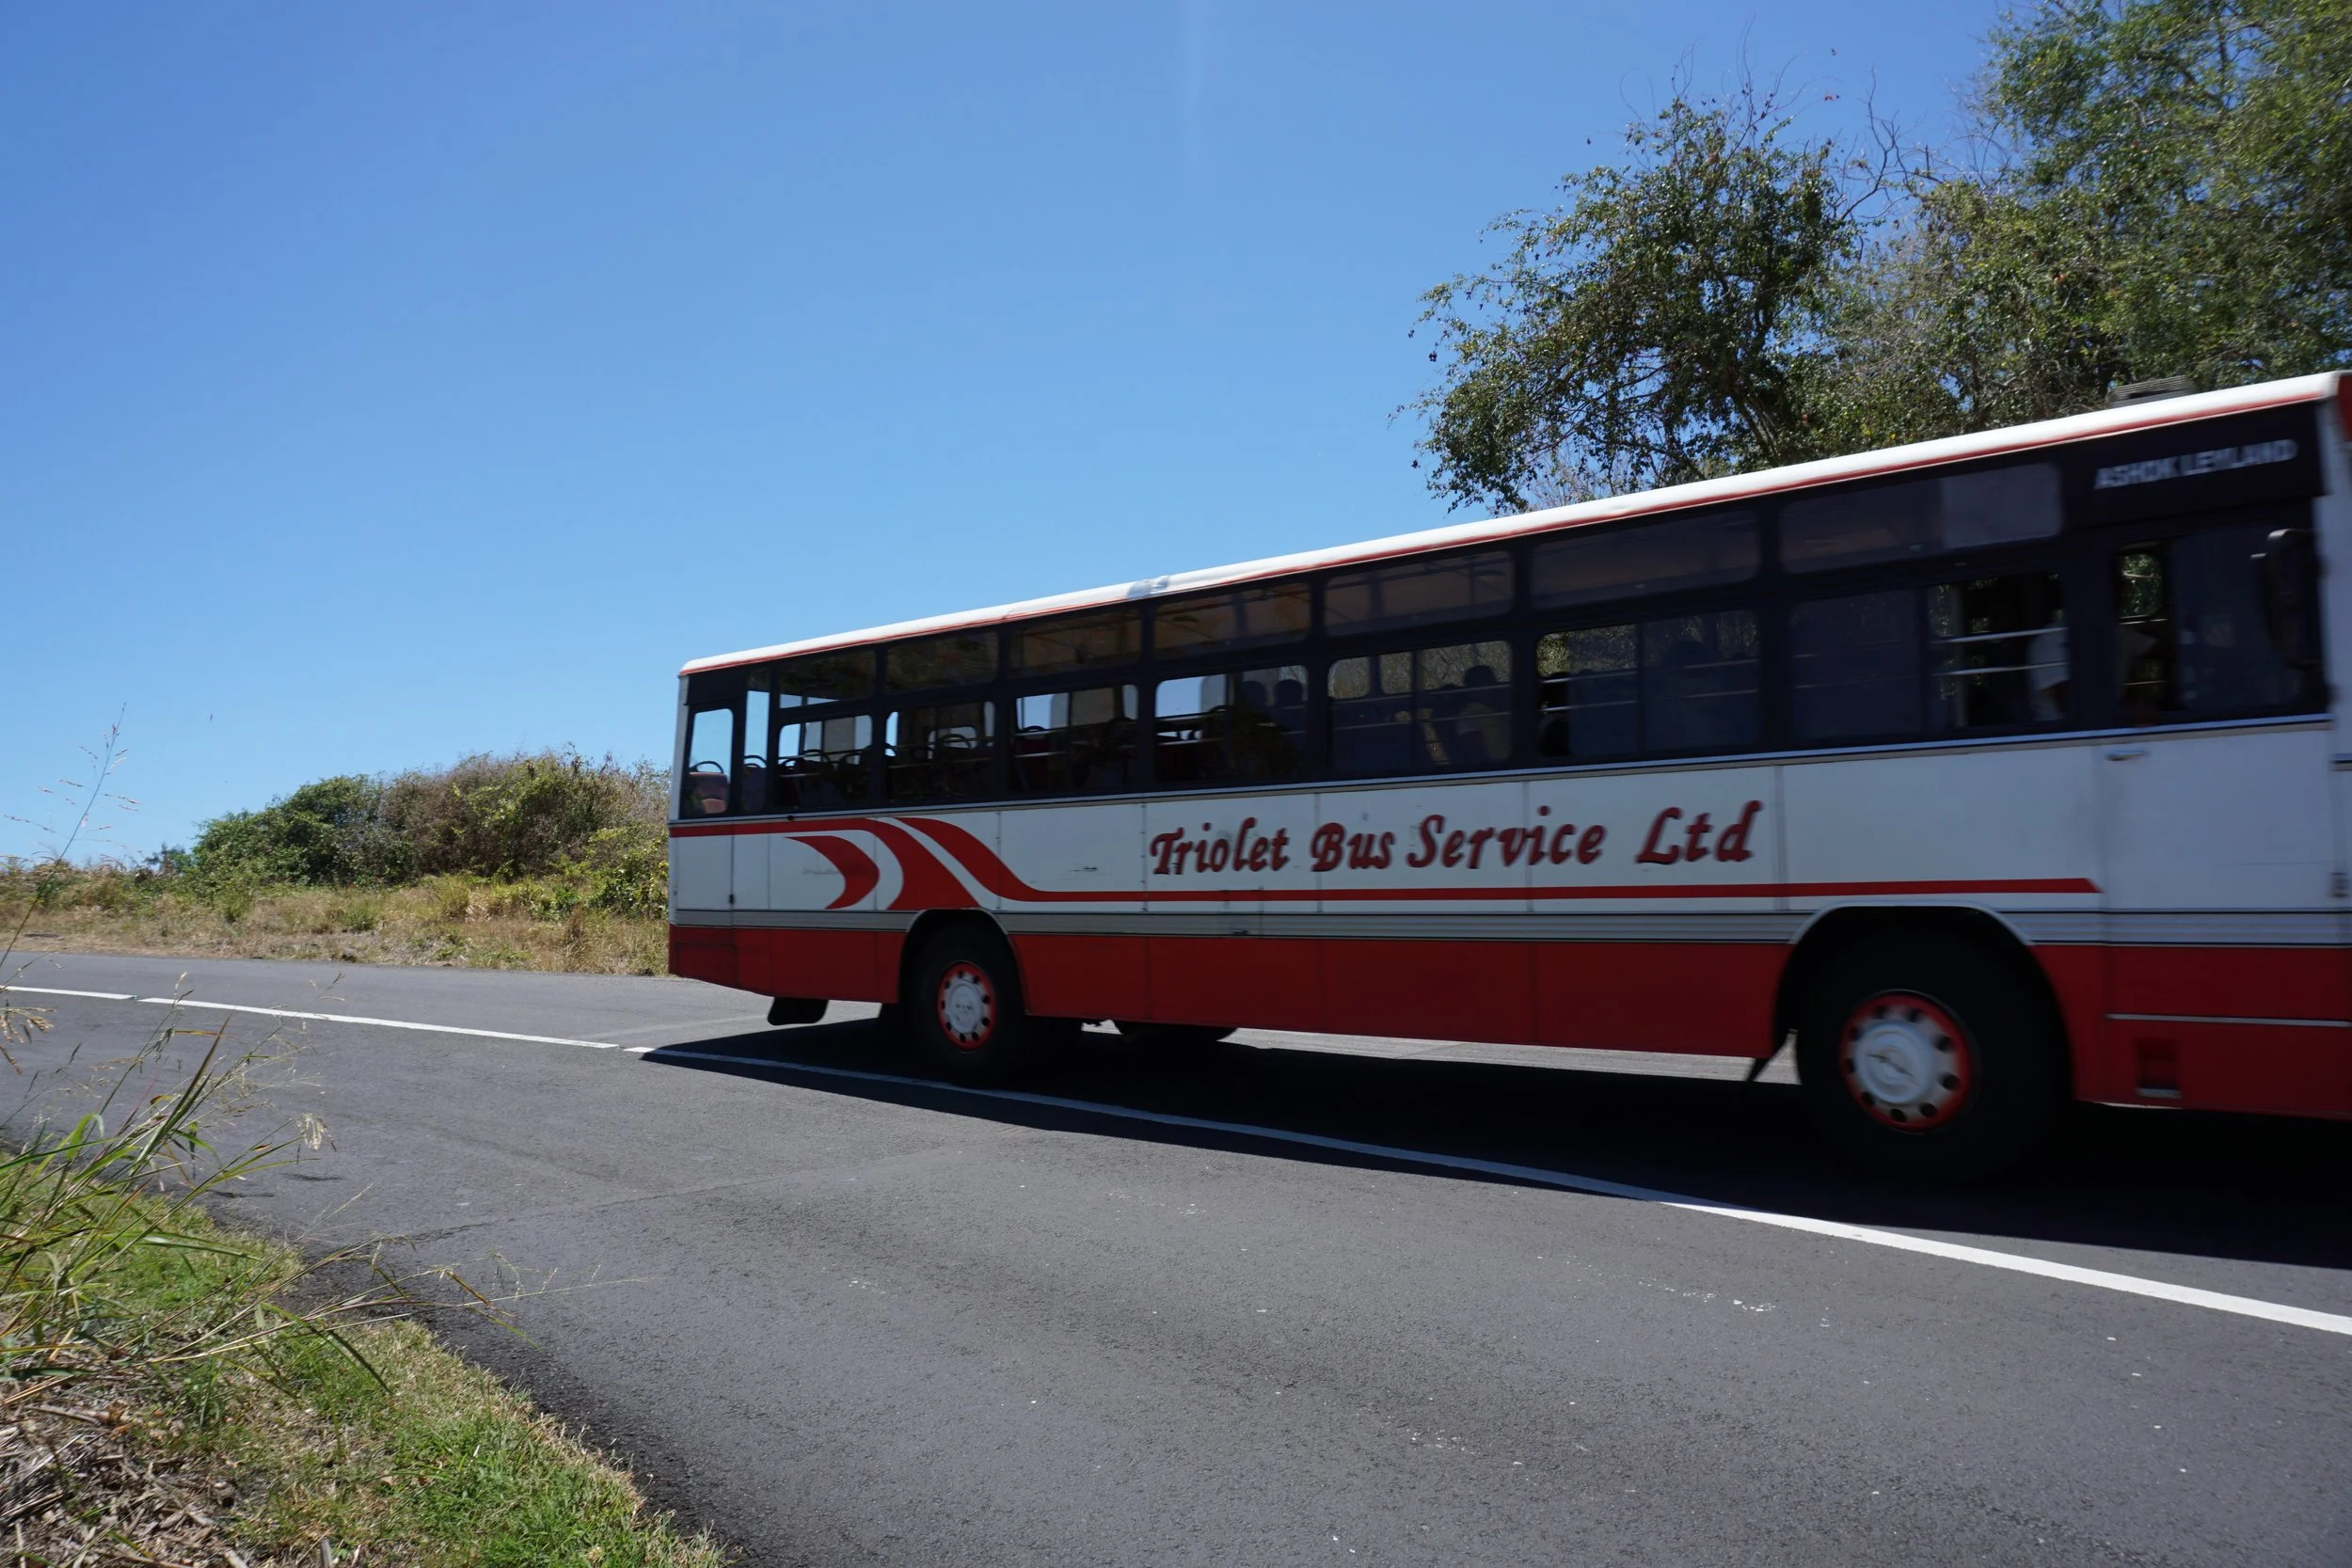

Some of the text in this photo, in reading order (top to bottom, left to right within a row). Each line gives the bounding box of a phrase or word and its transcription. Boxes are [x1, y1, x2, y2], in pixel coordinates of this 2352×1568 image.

[2094, 438, 2298, 489] ASHOK LEYLAND
[1150, 800, 1762, 876] Triolet Bus Service Ltd
